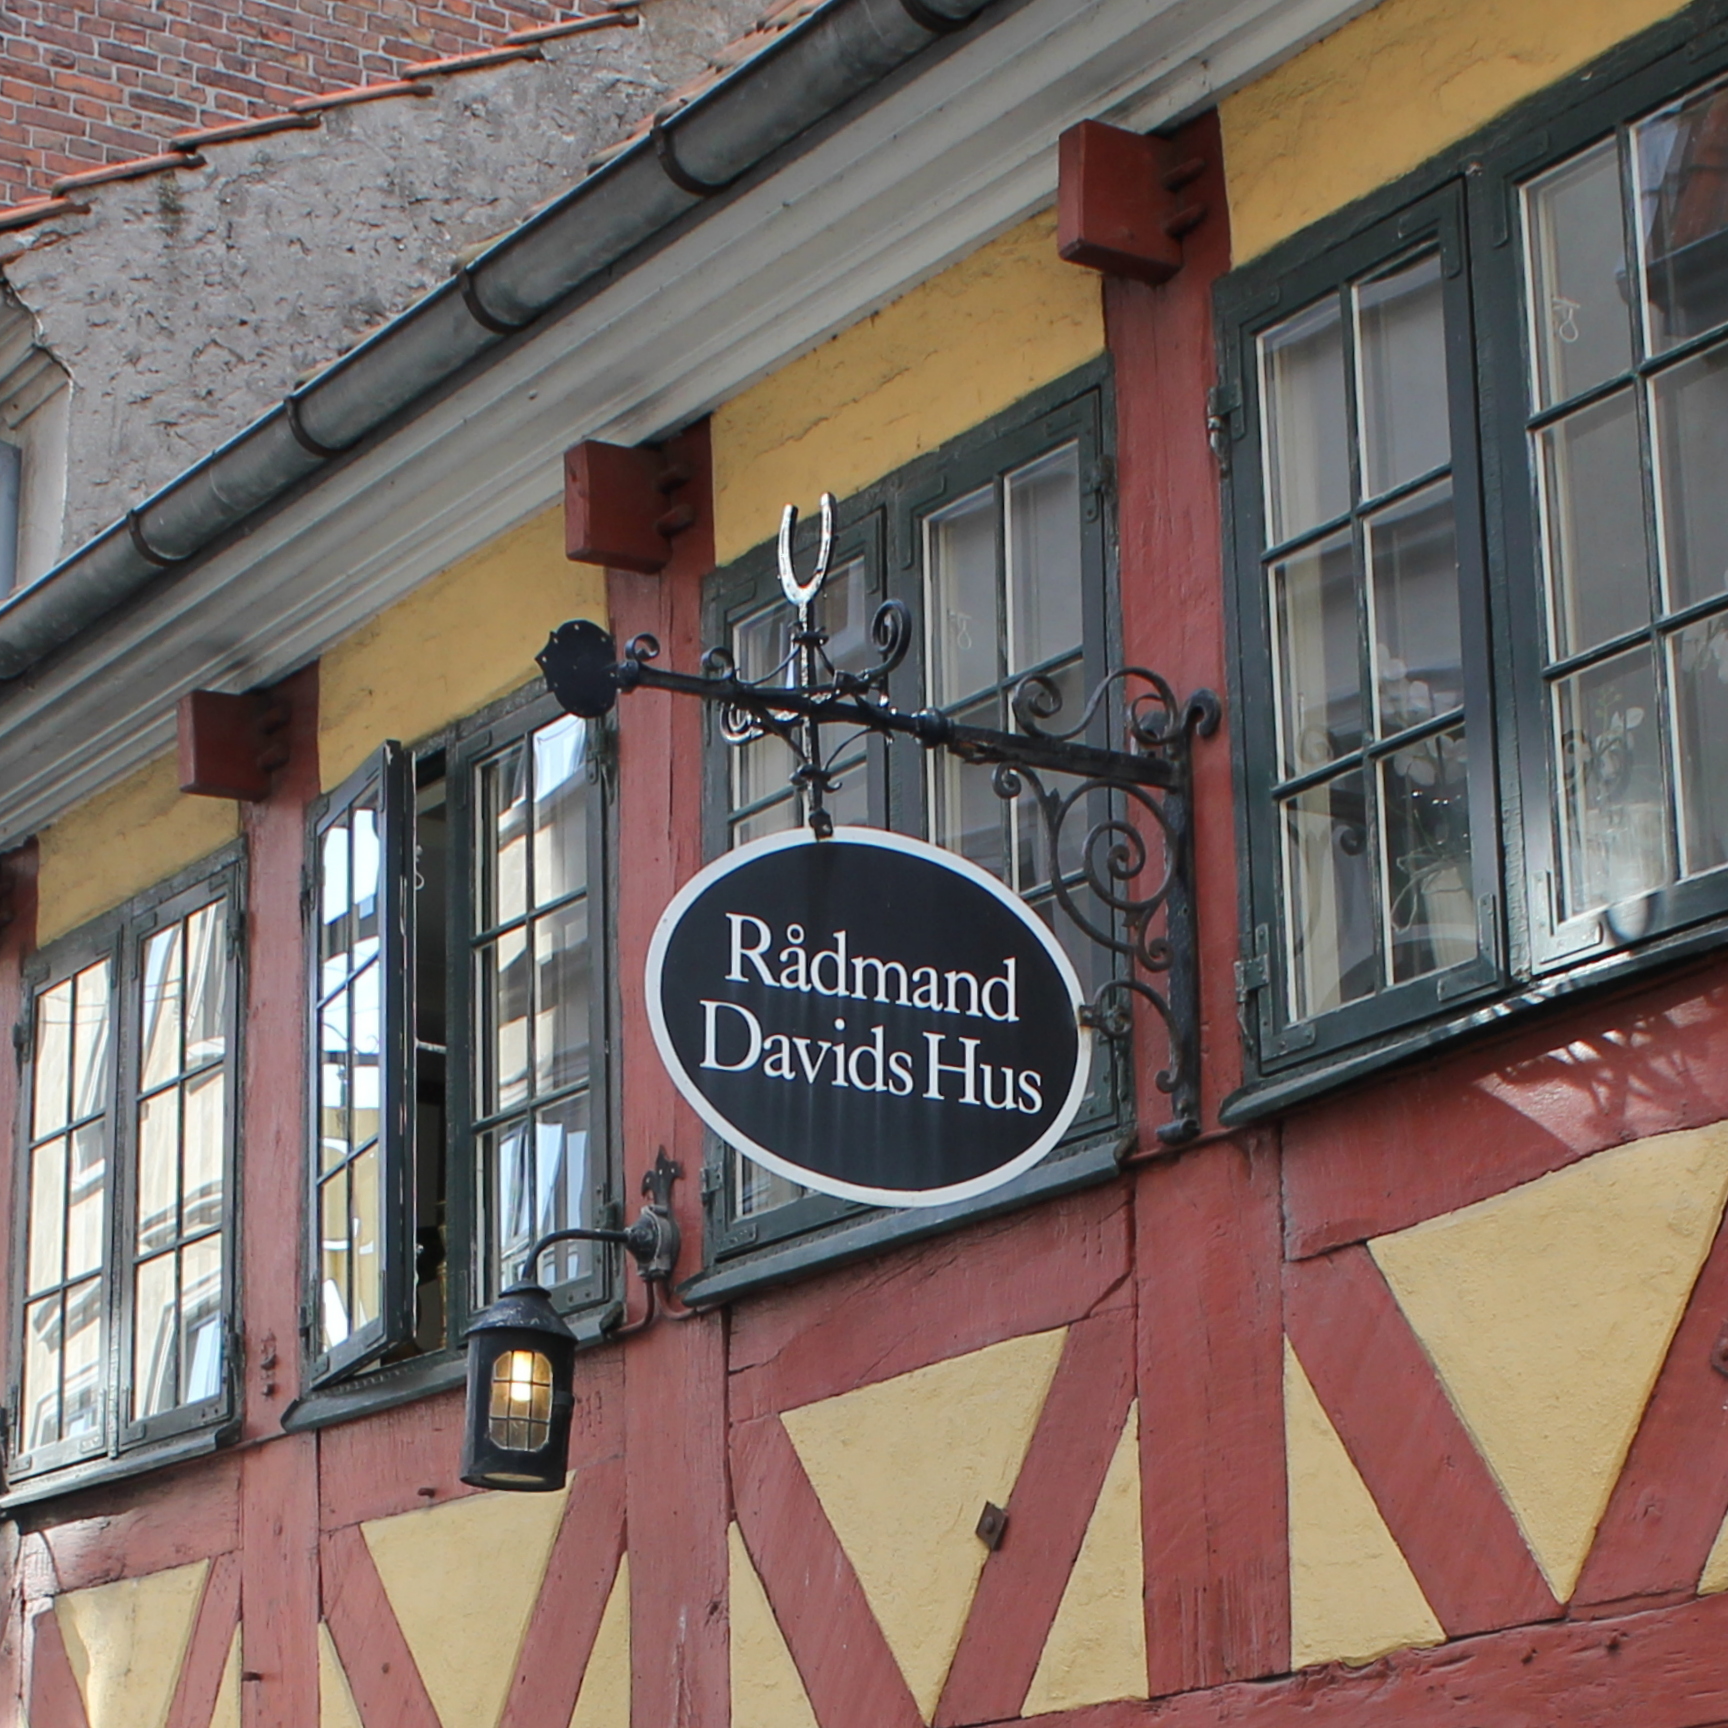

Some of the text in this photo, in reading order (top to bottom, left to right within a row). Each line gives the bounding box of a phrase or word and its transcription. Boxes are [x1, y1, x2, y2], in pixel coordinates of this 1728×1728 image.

[724, 912, 1020, 1023] Rådmand
[699, 1000, 1043, 1115] Davids Hus
